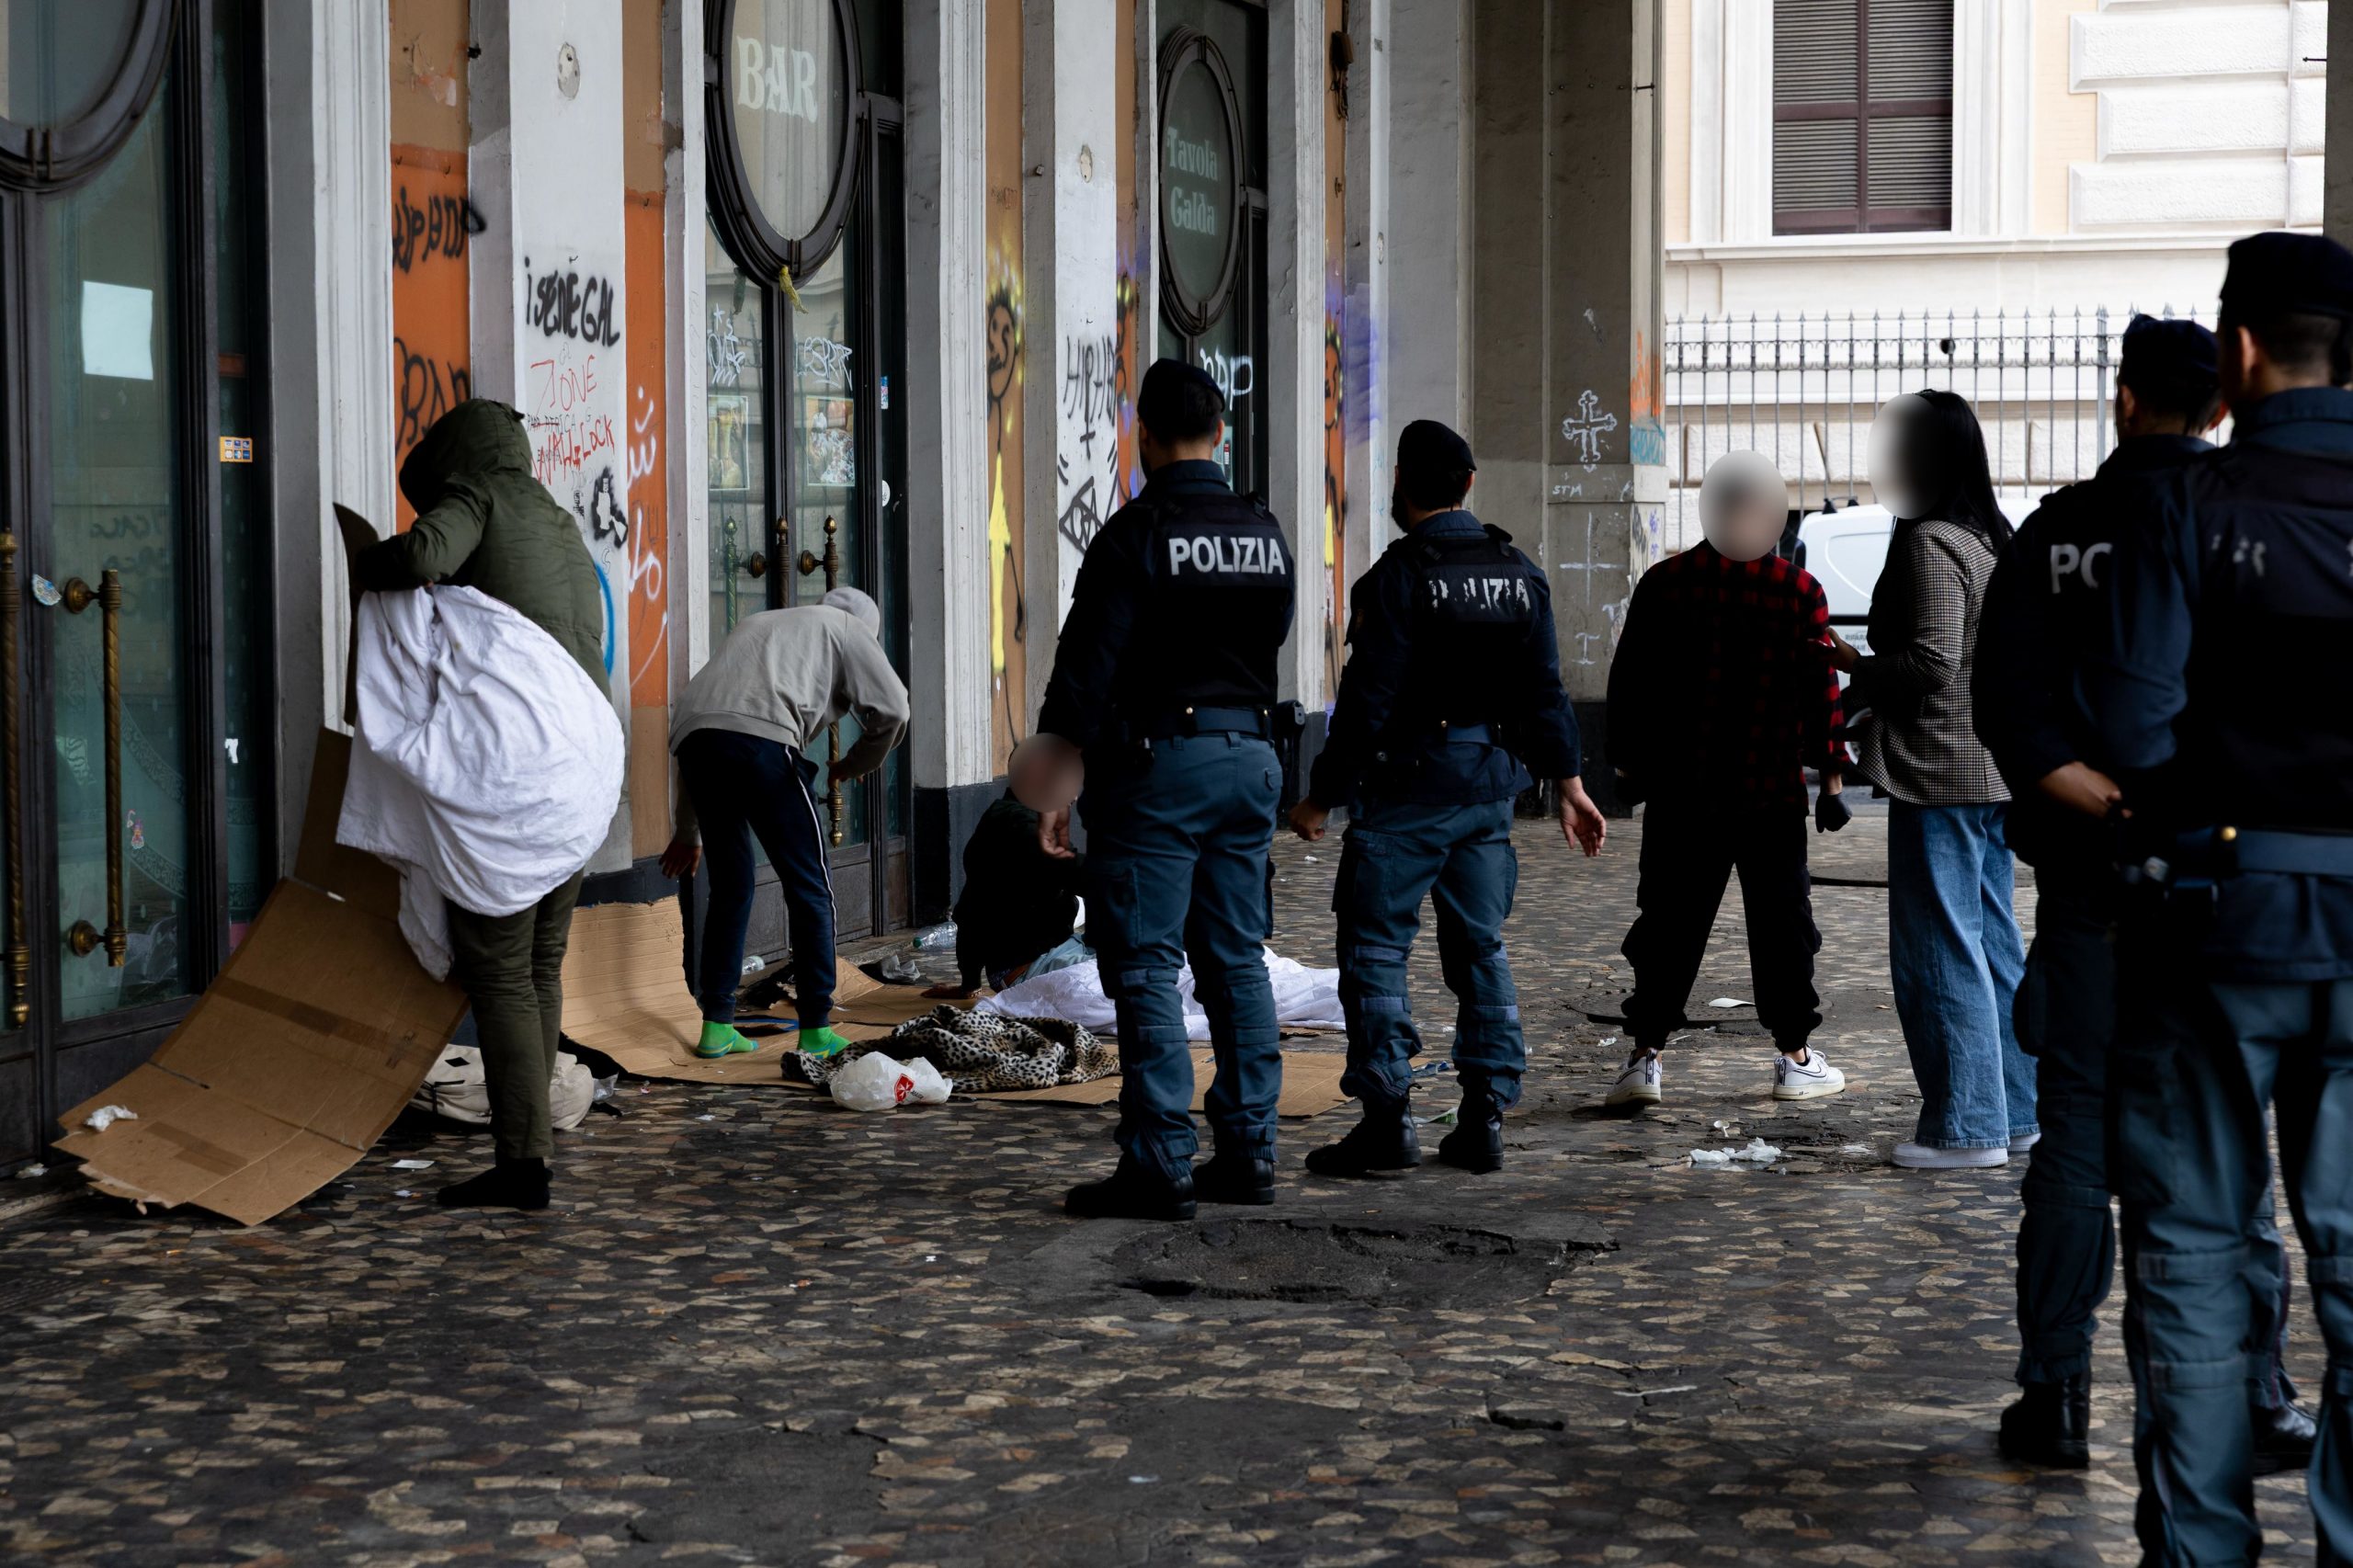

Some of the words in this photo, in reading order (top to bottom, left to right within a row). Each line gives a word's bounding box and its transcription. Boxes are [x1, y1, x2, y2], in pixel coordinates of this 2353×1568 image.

[736, 36, 817, 122] BAR
[1166, 126, 1218, 181] Tavola
[1168, 536, 1286, 575] POLIZIA
